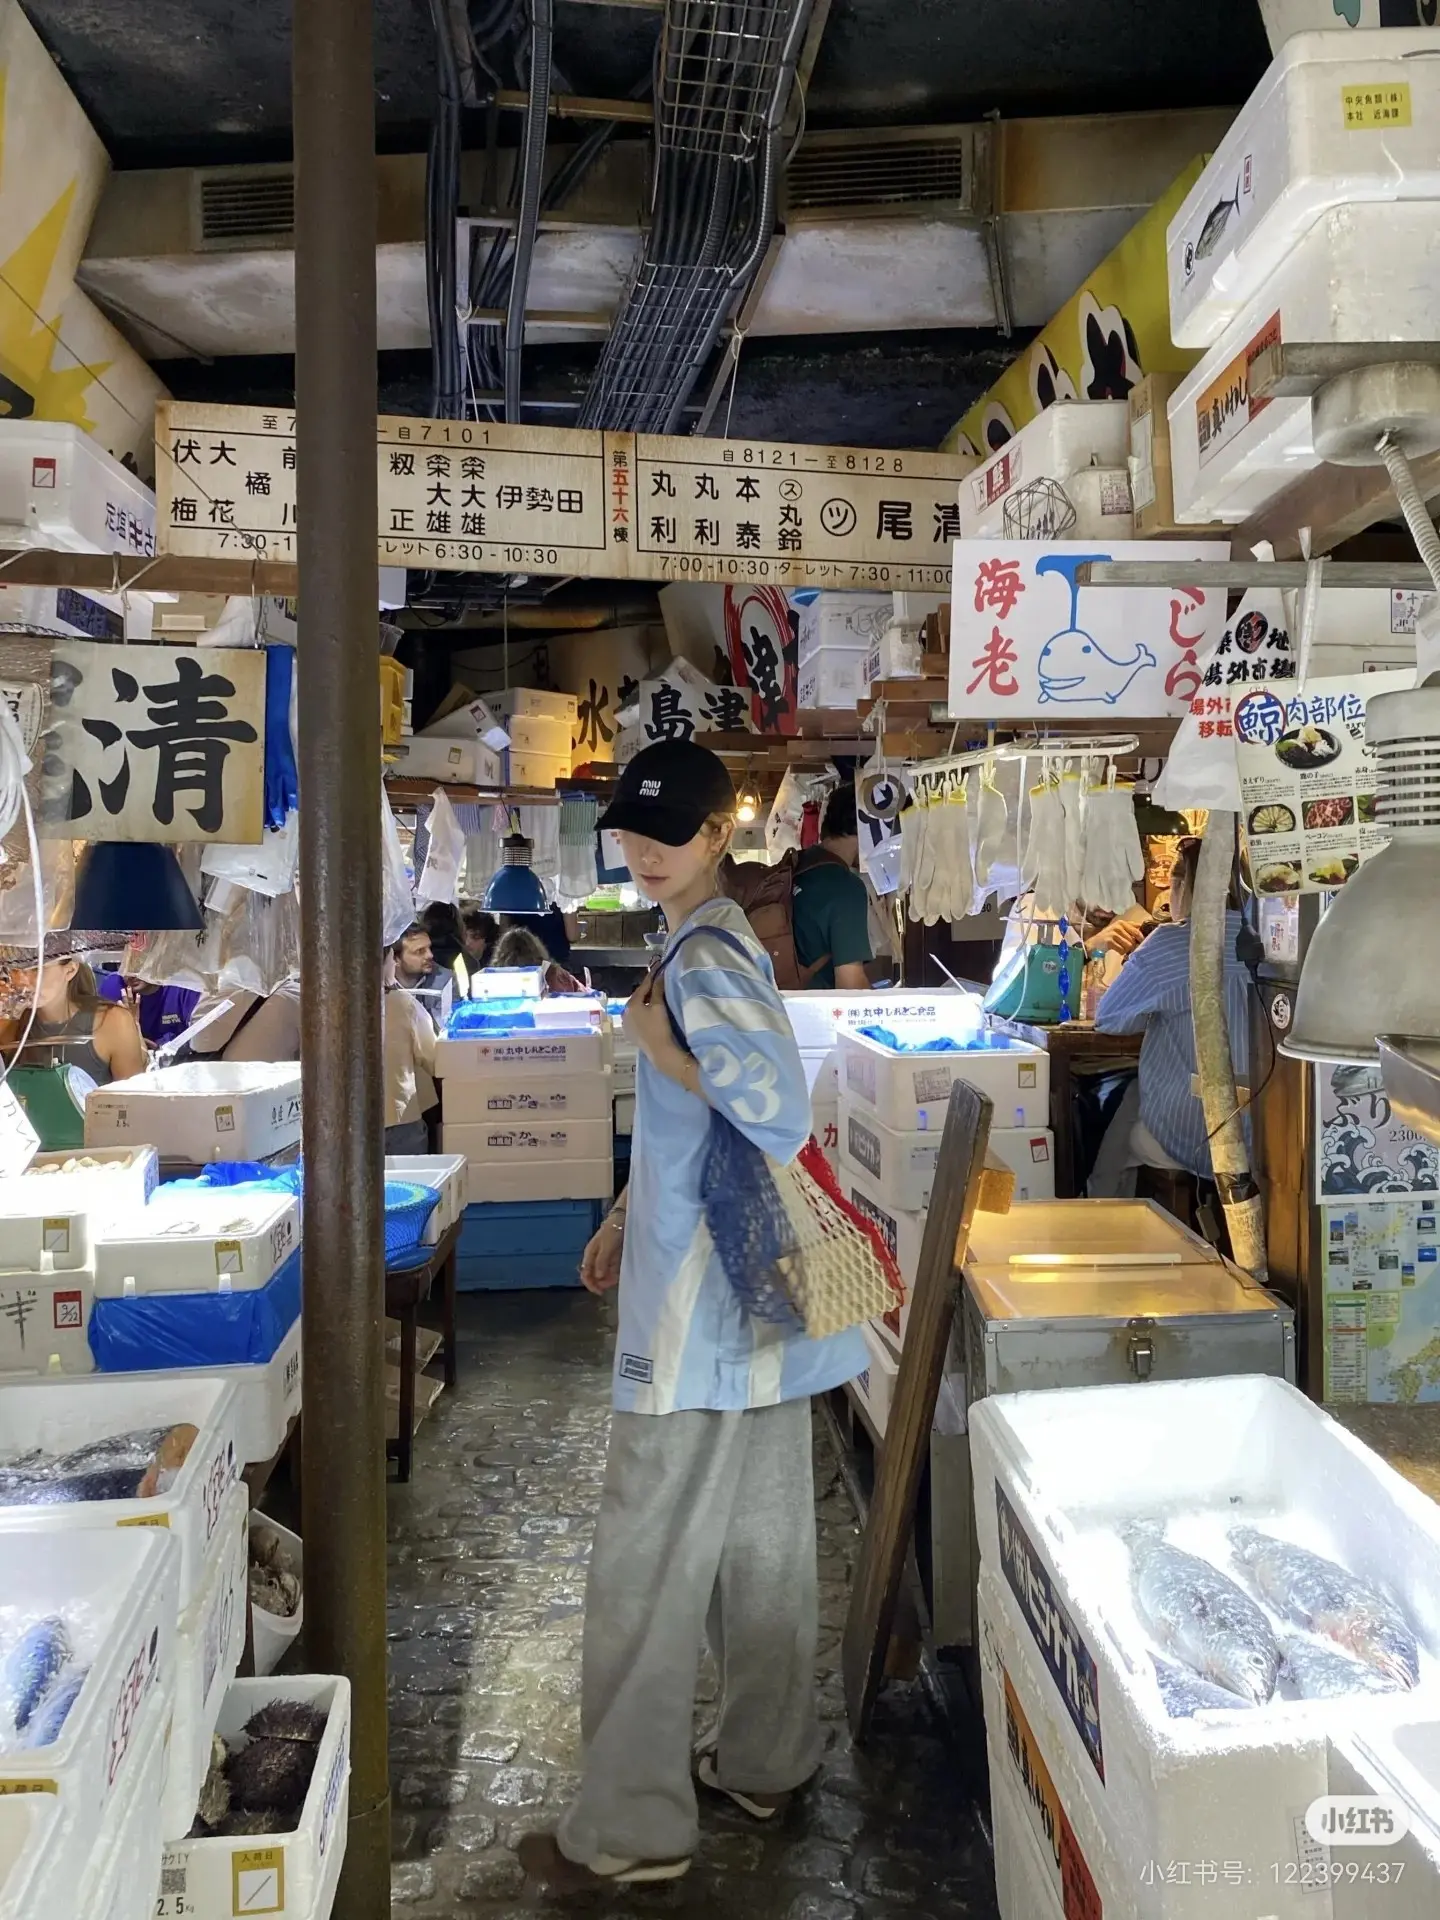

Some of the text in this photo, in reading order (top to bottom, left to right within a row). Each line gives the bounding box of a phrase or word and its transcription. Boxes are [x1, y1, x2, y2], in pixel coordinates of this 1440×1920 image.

[421, 424, 490, 444] 7101
[743, 448, 798, 466] 8121
[845, 455, 904, 473] 8128
[495, 484, 583, 514] 伊勢田
[611, 450, 629, 543] 第五十六棟
[435, 543, 483, 560] 6:30
[504, 547, 558, 564] 10:30
[966, 557, 1026, 697] 海老
[644, 682, 750, 742] 島津
[1189, 697, 1231, 717] 場外
[1322, 1092, 1392, 1130] ぶり
[241, 1851, 274, 1864] 入荷日
